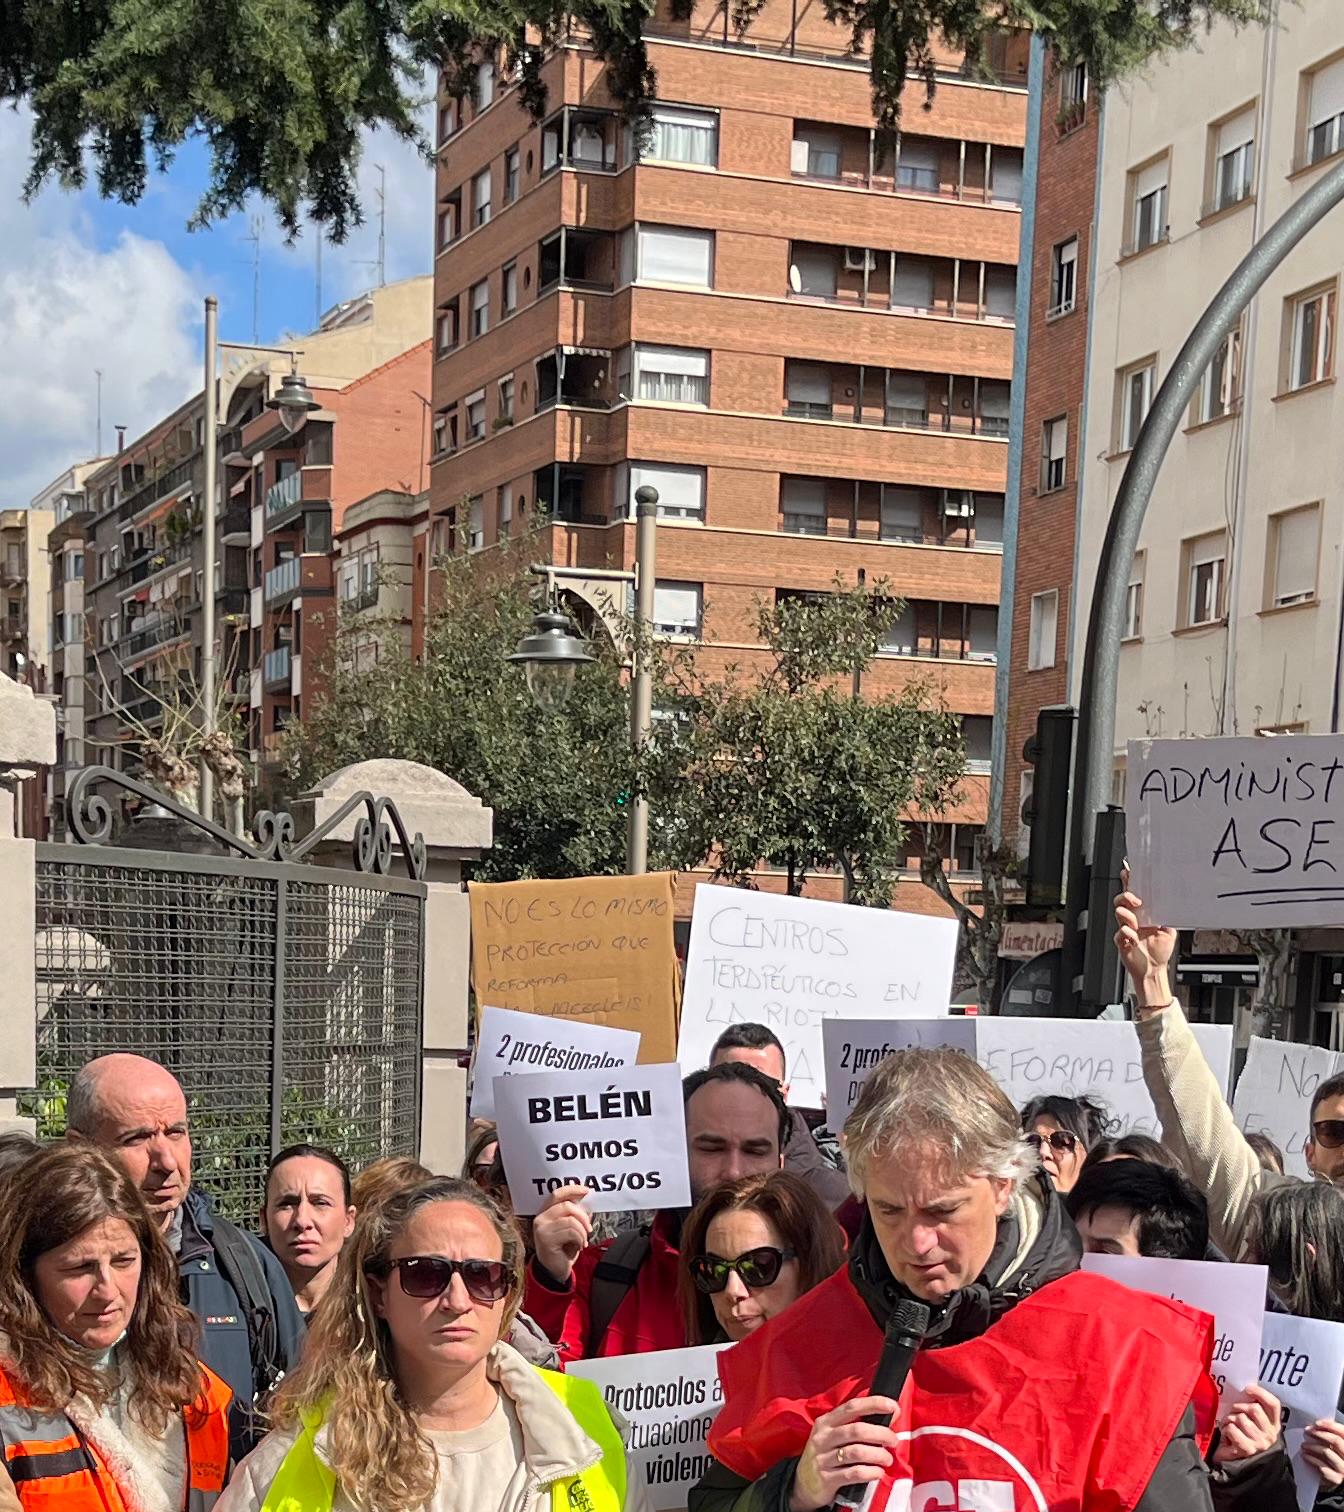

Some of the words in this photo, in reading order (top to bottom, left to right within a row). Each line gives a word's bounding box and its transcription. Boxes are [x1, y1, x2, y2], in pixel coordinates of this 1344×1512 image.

[709, 906, 849, 956] CENTROS
[883, 982, 922, 1002] EN
[763, 1001, 841, 1027] RIOJ
[496, 1034, 511, 1057] 2
[840, 1043, 853, 1070] 2
[528, 1084, 653, 1124] BELÉN
[545, 1138, 639, 1162] SOMOS
[1259, 1346, 1309, 1388] nte
